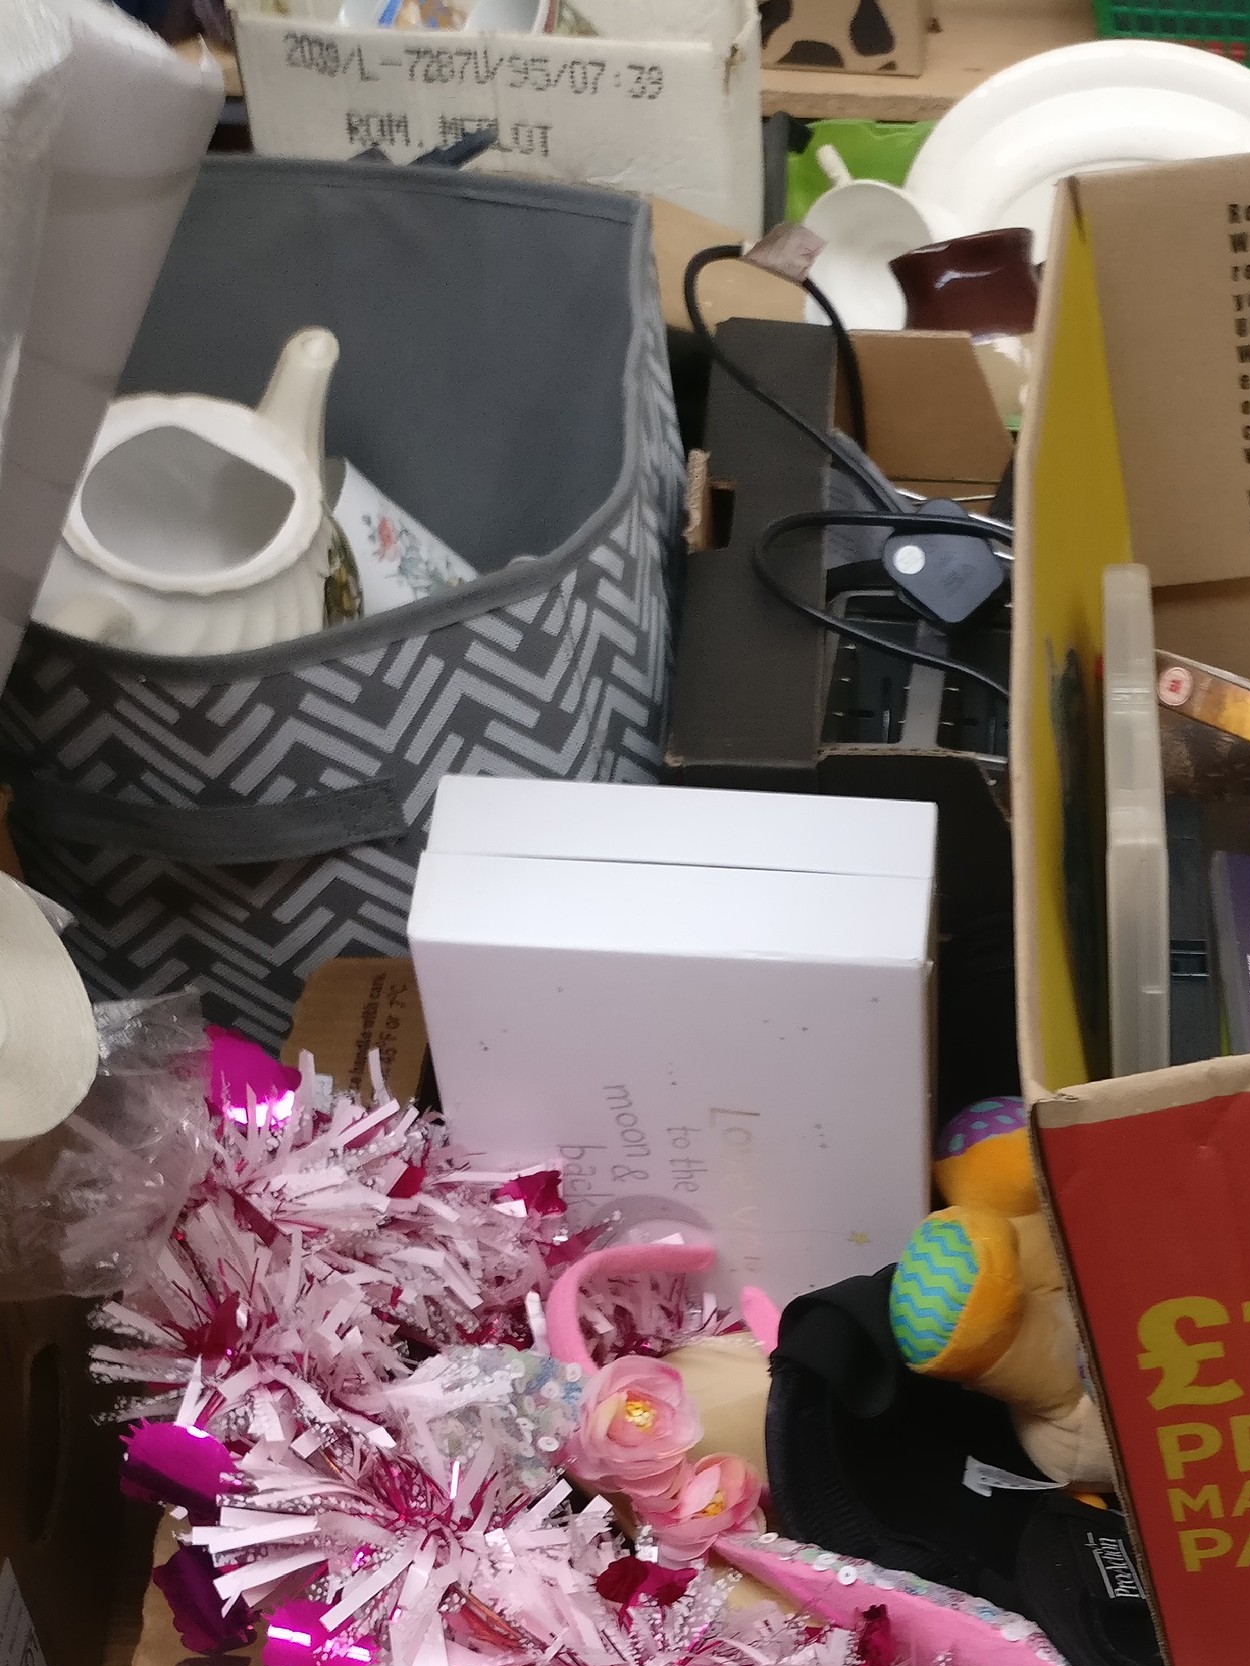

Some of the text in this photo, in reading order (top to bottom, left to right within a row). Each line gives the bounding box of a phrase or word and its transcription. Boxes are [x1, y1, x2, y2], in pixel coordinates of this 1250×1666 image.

[603, 1084, 651, 1182] moon &
[666, 1127, 708, 1192] to the
[556, 1144, 615, 1207] back
